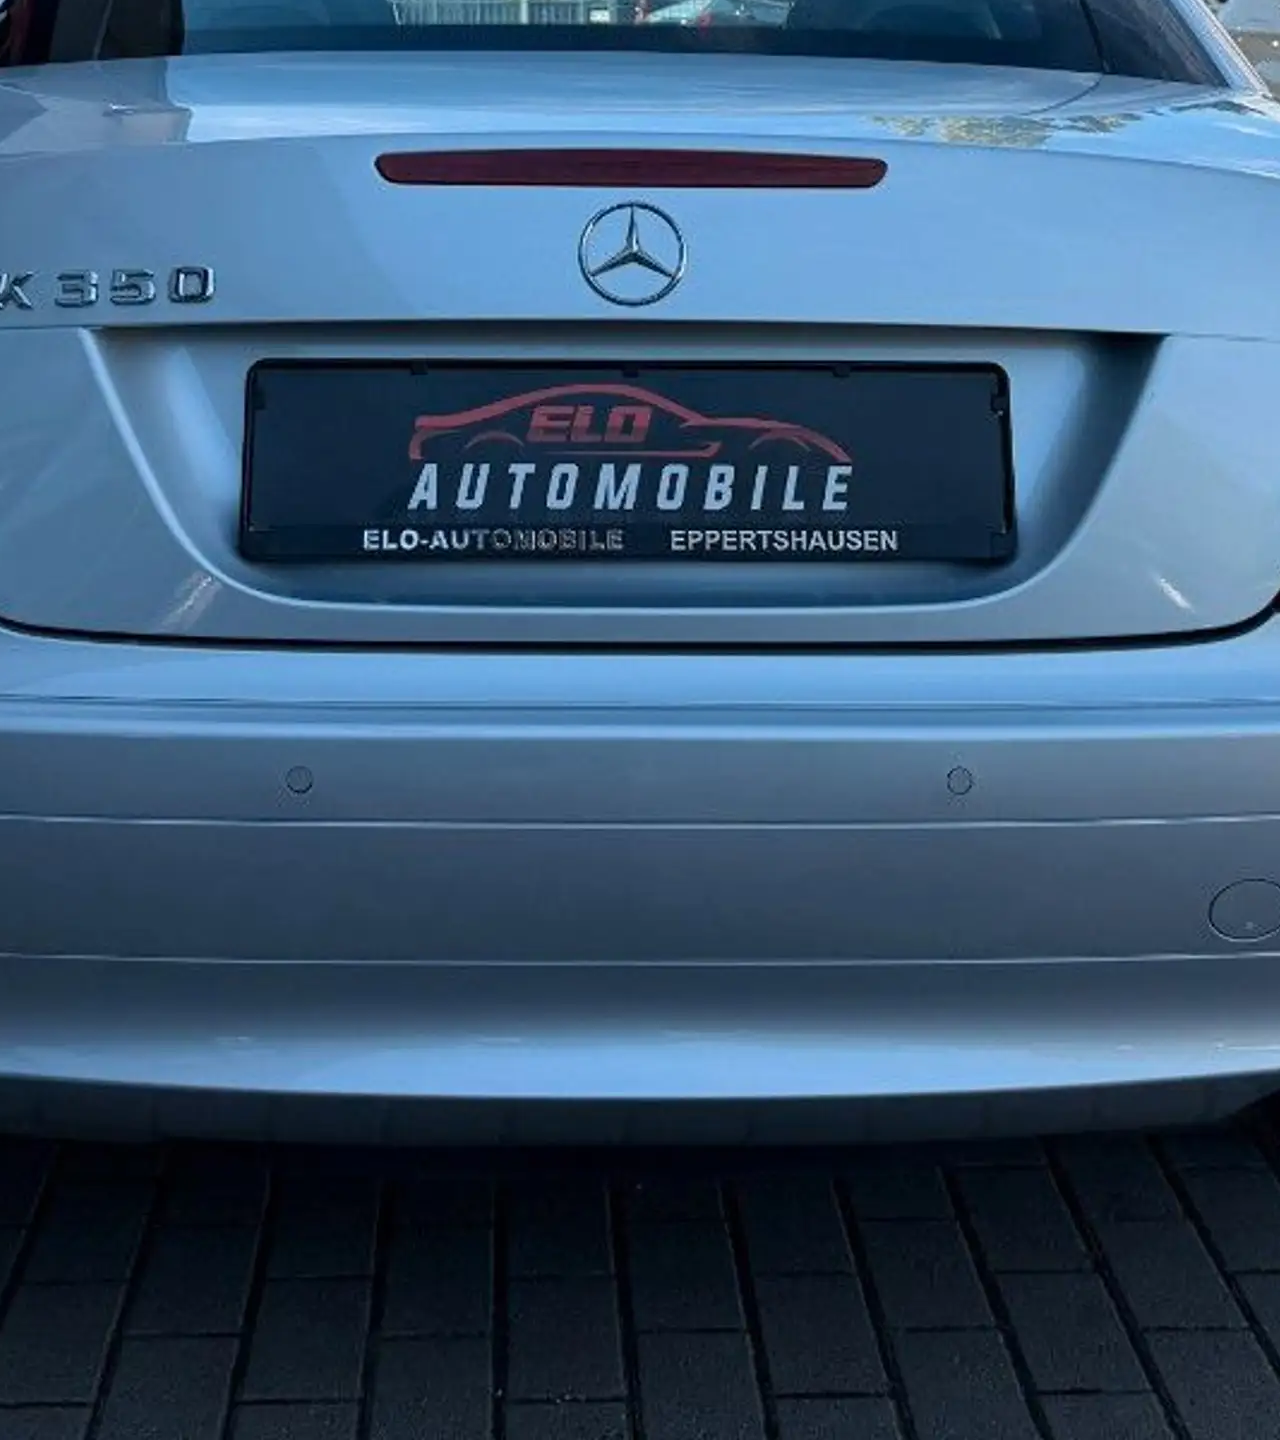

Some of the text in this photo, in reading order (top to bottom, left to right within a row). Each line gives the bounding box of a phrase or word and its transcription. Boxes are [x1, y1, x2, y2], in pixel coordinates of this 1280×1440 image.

[526, 404, 651, 444] ELO
[407, 462, 853, 511] AUTOMOBILE
[362, 528, 898, 553] ELO-AUTOMOBILE EPPERTSHAUSEN
